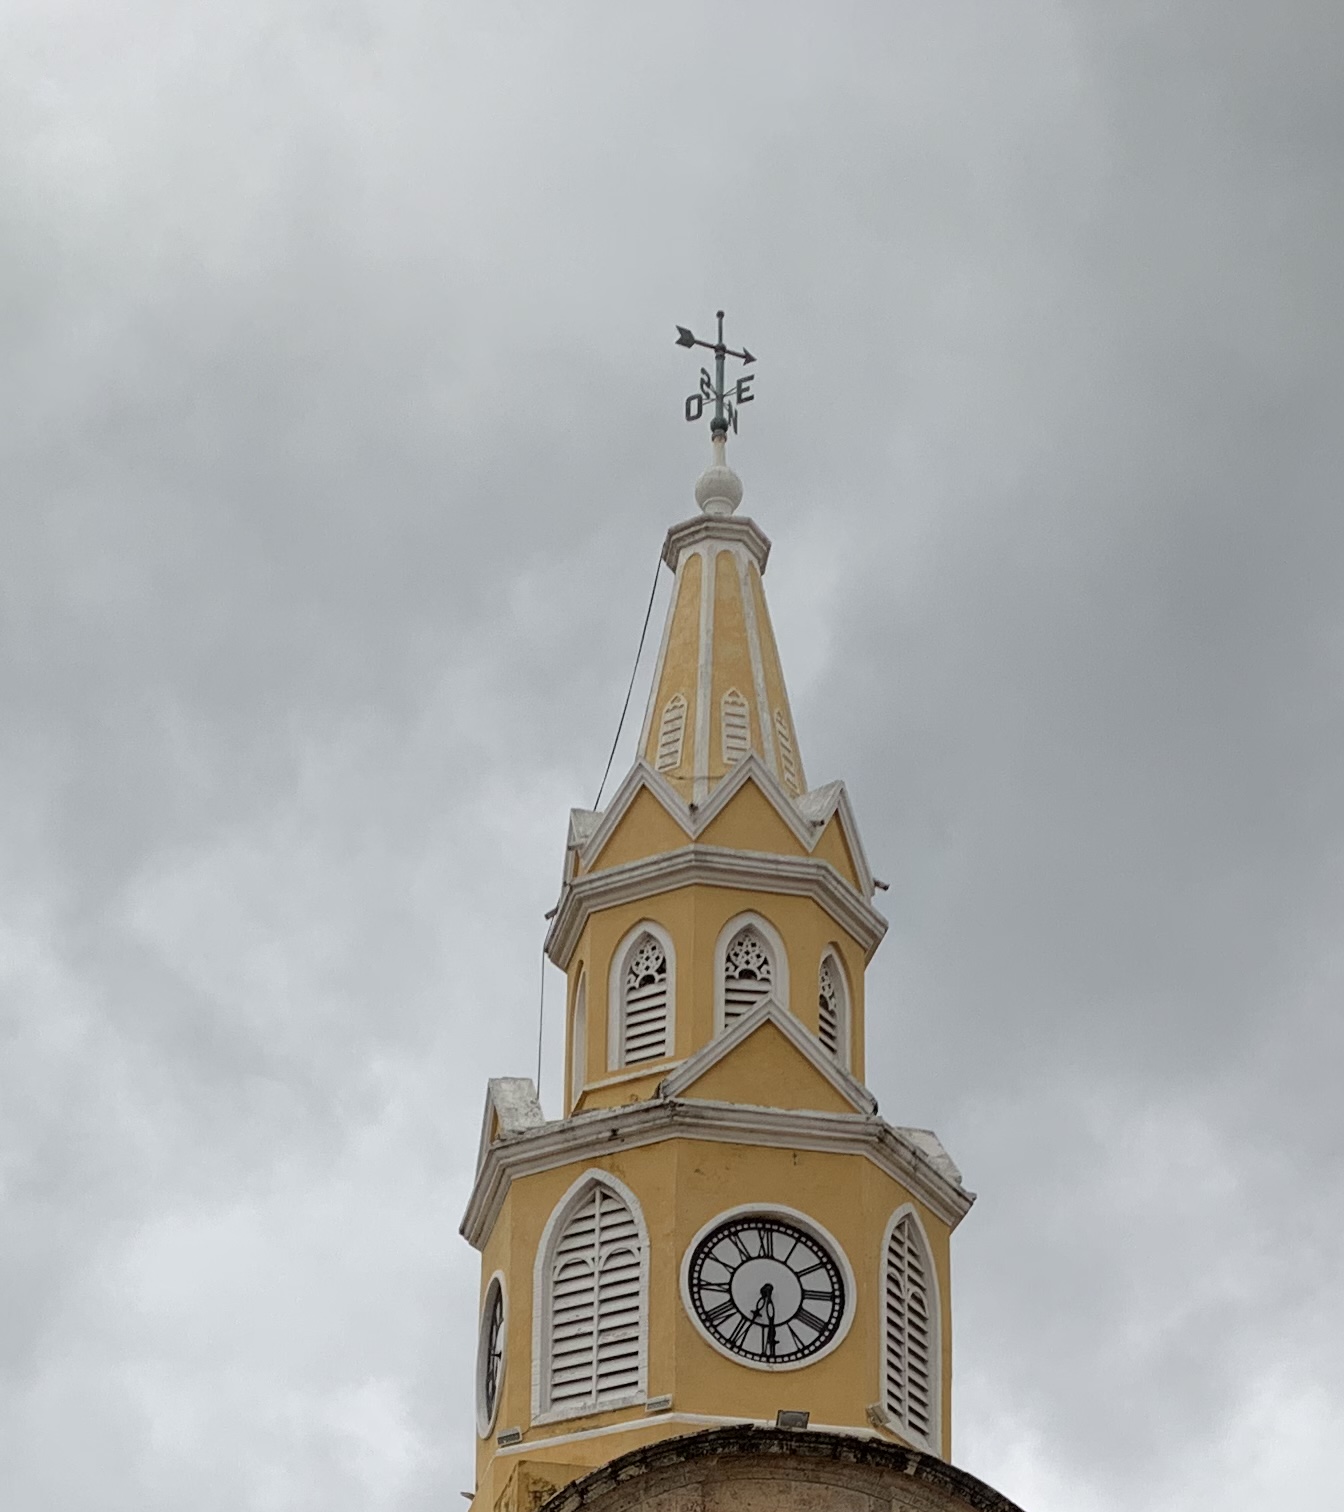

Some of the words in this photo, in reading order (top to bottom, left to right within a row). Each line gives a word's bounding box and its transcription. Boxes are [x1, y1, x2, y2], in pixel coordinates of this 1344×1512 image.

[736, 374, 755, 404] E
[685, 393, 703, 422] O
[727, 400, 738, 435] N
[758, 1229, 775, 1258] XII
